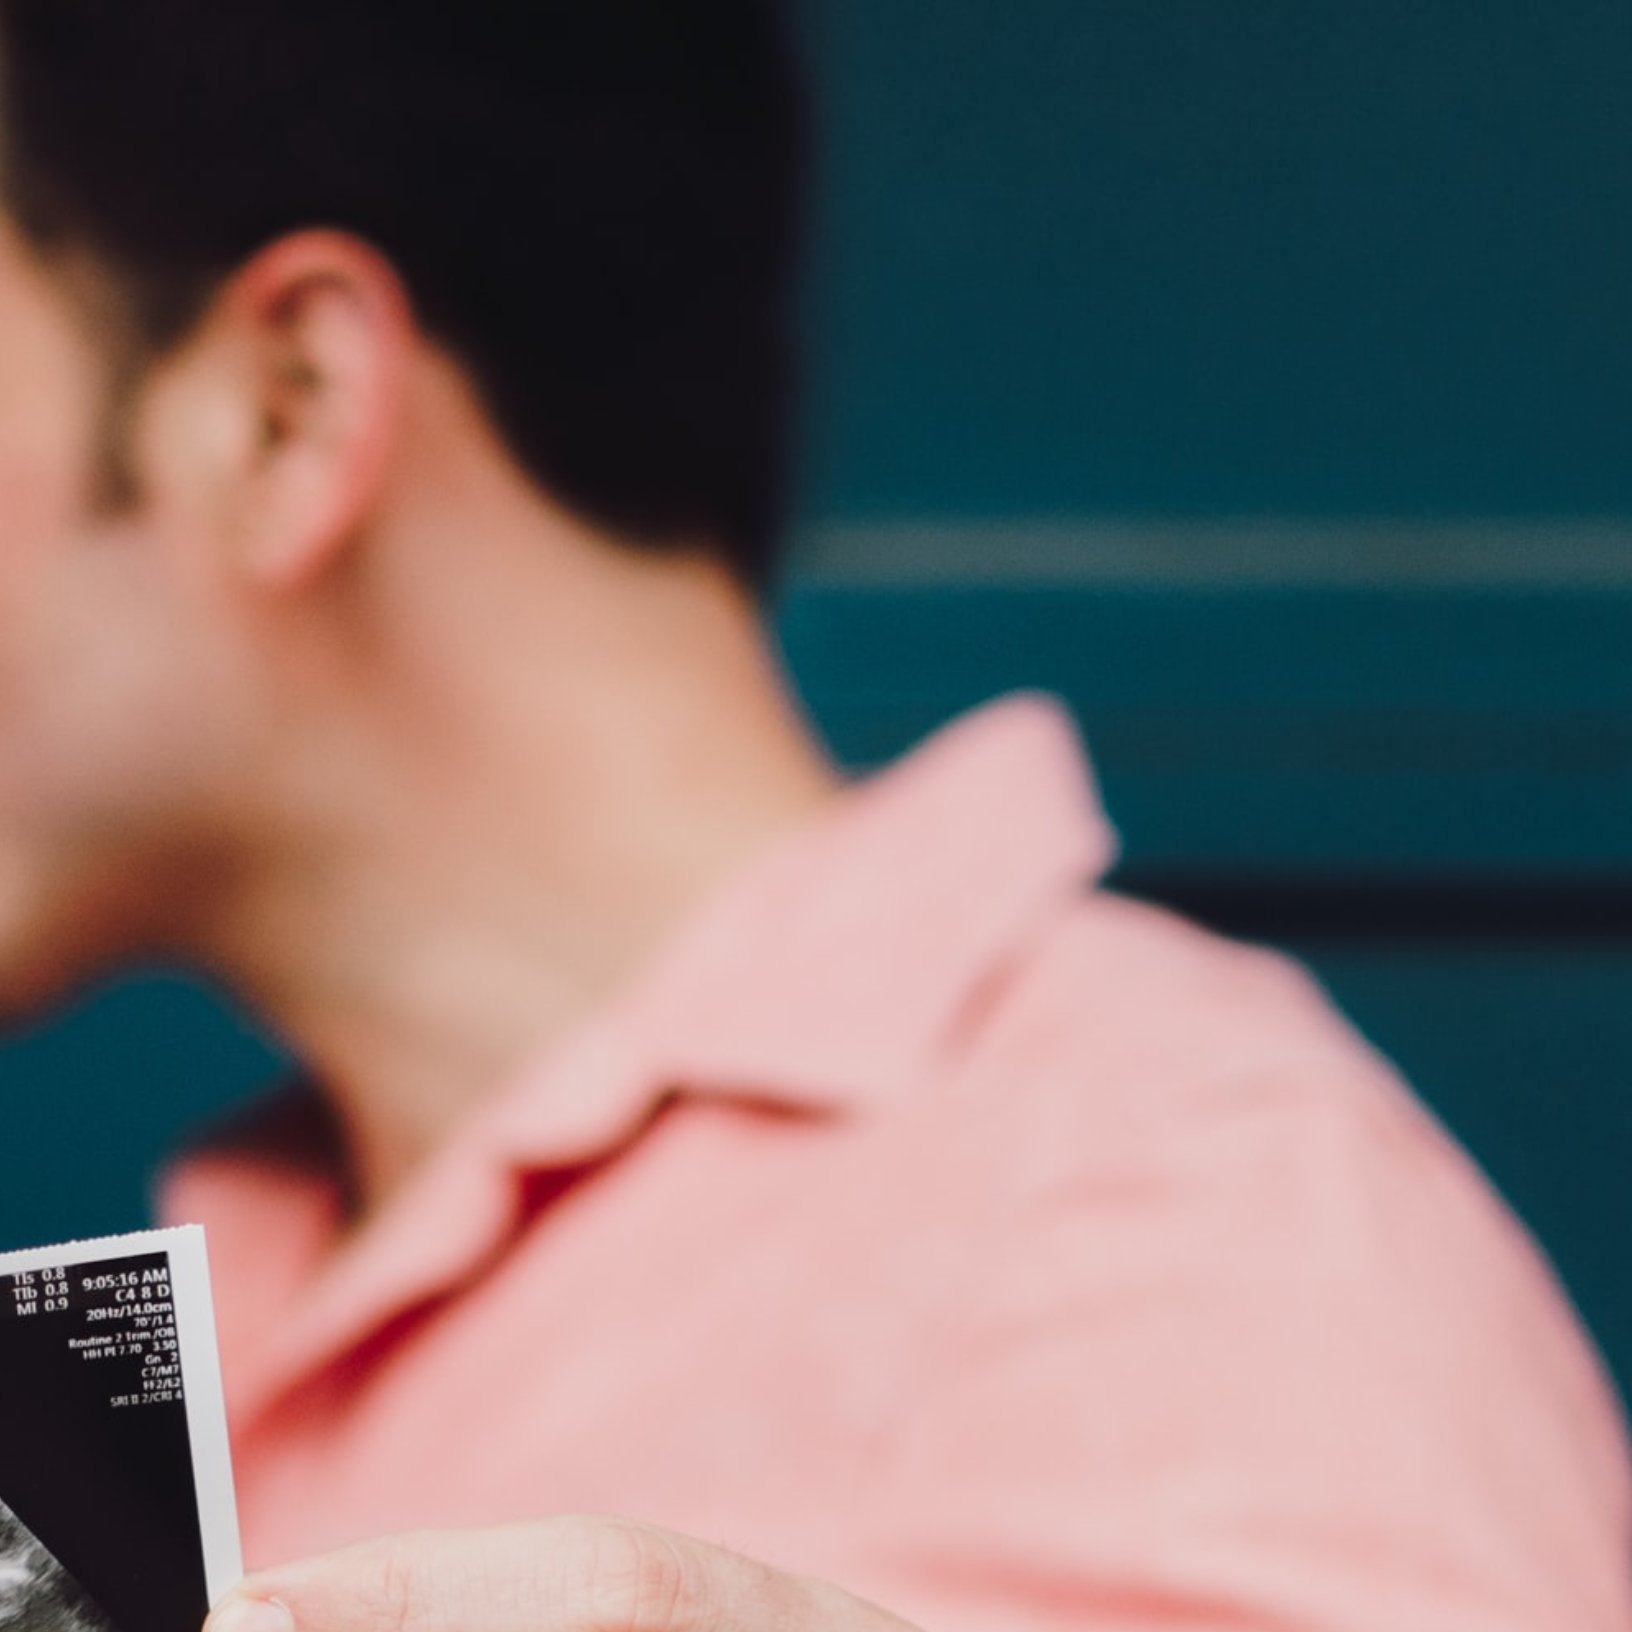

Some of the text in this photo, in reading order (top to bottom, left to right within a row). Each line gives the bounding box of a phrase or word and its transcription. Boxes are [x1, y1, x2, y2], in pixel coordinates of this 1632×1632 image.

[41, 1267, 66, 1282] 0.8
[82, 1268, 168, 1291] 9:05:16 AM
[45, 1282, 69, 1296] 0.8
[45, 1297, 69, 1311] 0.9
[86, 1302, 172, 1322] 20Hz/14.0cm
[68, 1335, 113, 1349] Routine
[115, 1333, 123, 1343] 2
